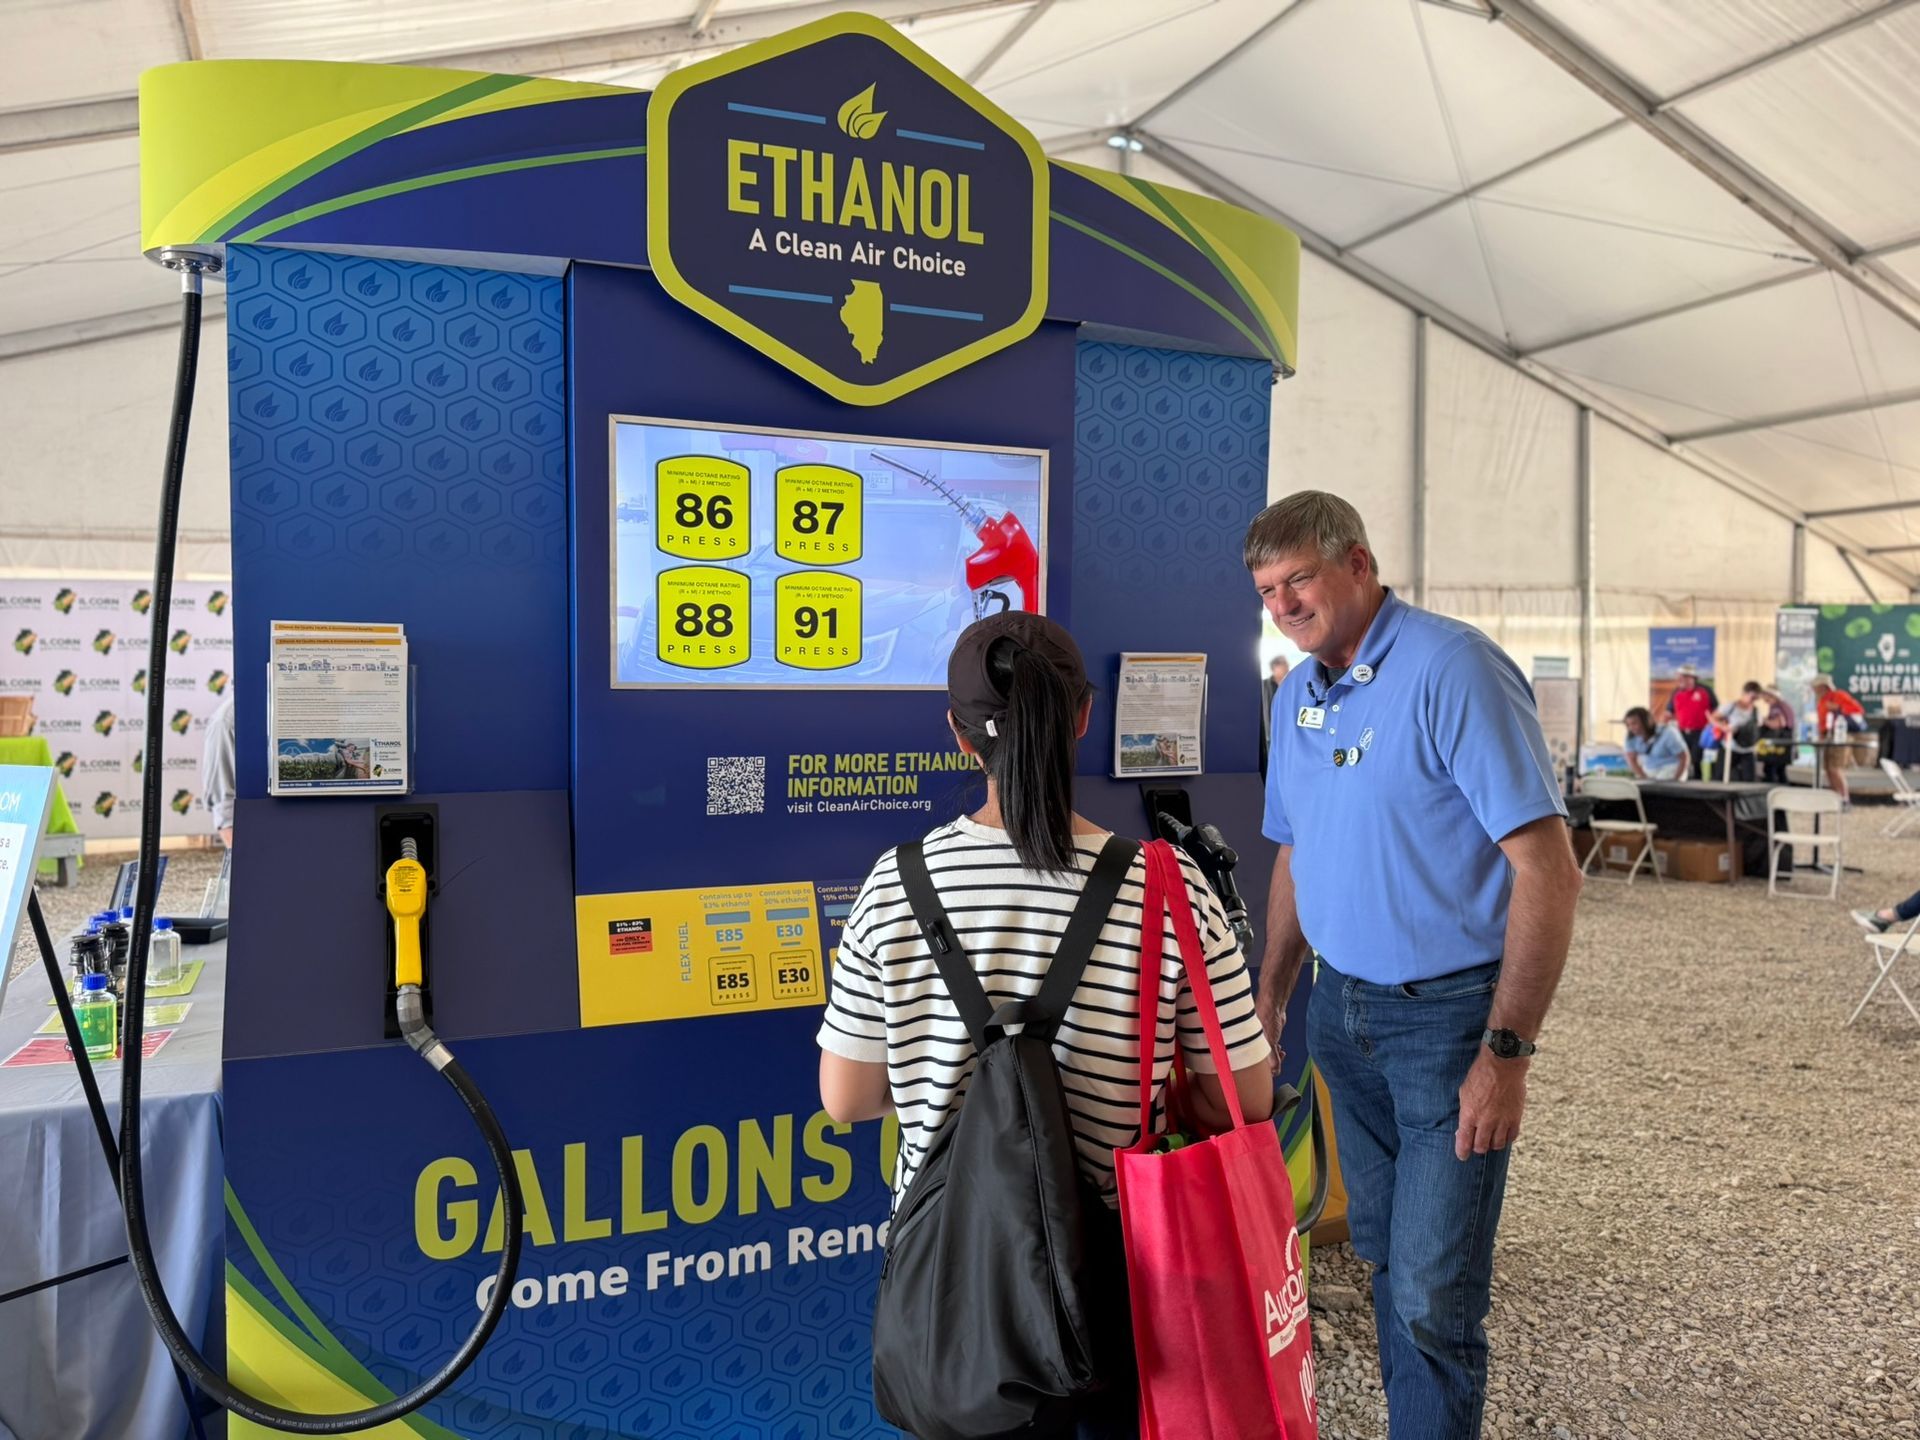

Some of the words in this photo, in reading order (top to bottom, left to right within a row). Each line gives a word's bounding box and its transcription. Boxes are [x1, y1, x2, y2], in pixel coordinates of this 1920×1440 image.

[727, 138, 984, 245] ETHANOL
[748, 227, 767, 252] A
[775, 231, 842, 261] Clean
[850, 240, 886, 266] Air
[892, 246, 966, 277] Choice
[675, 493, 733, 529] 86
[792, 500, 844, 535] 87
[667, 534, 736, 547] PRESS
[785, 541, 849, 552] PRESS
[172, 598, 195, 606] ORN
[675, 602, 733, 638] 88
[794, 606, 837, 639] 91
[667, 644, 736, 655] PRESS
[785, 646, 848, 656] PRESS
[788, 754, 828, 775] FOR
[834, 753, 889, 773] MORE
[895, 752, 981, 772] ETHANOL
[787, 775, 918, 798] INFORMATION
[787, 802, 813, 814] visit
[817, 799, 931, 813] CleanAirChoice.org
[699, 892, 732, 901] Contains
[759, 889, 790, 897] Contains
[817, 885, 848, 893] Contains
[781, 896, 809, 904] ethanol
[678, 922, 689, 950] FUEL
[716, 928, 744, 943] E85
[776, 924, 803, 938] E30
[680, 953, 691, 982] FLEX
[778, 967, 810, 984] E30
[717, 972, 750, 990] E85
[719, 991, 750, 1000] PRESS
[780, 986, 811, 994] PRESS
[414, 1108, 853, 1261] GALLONS
[646, 1241, 772, 1291] From
